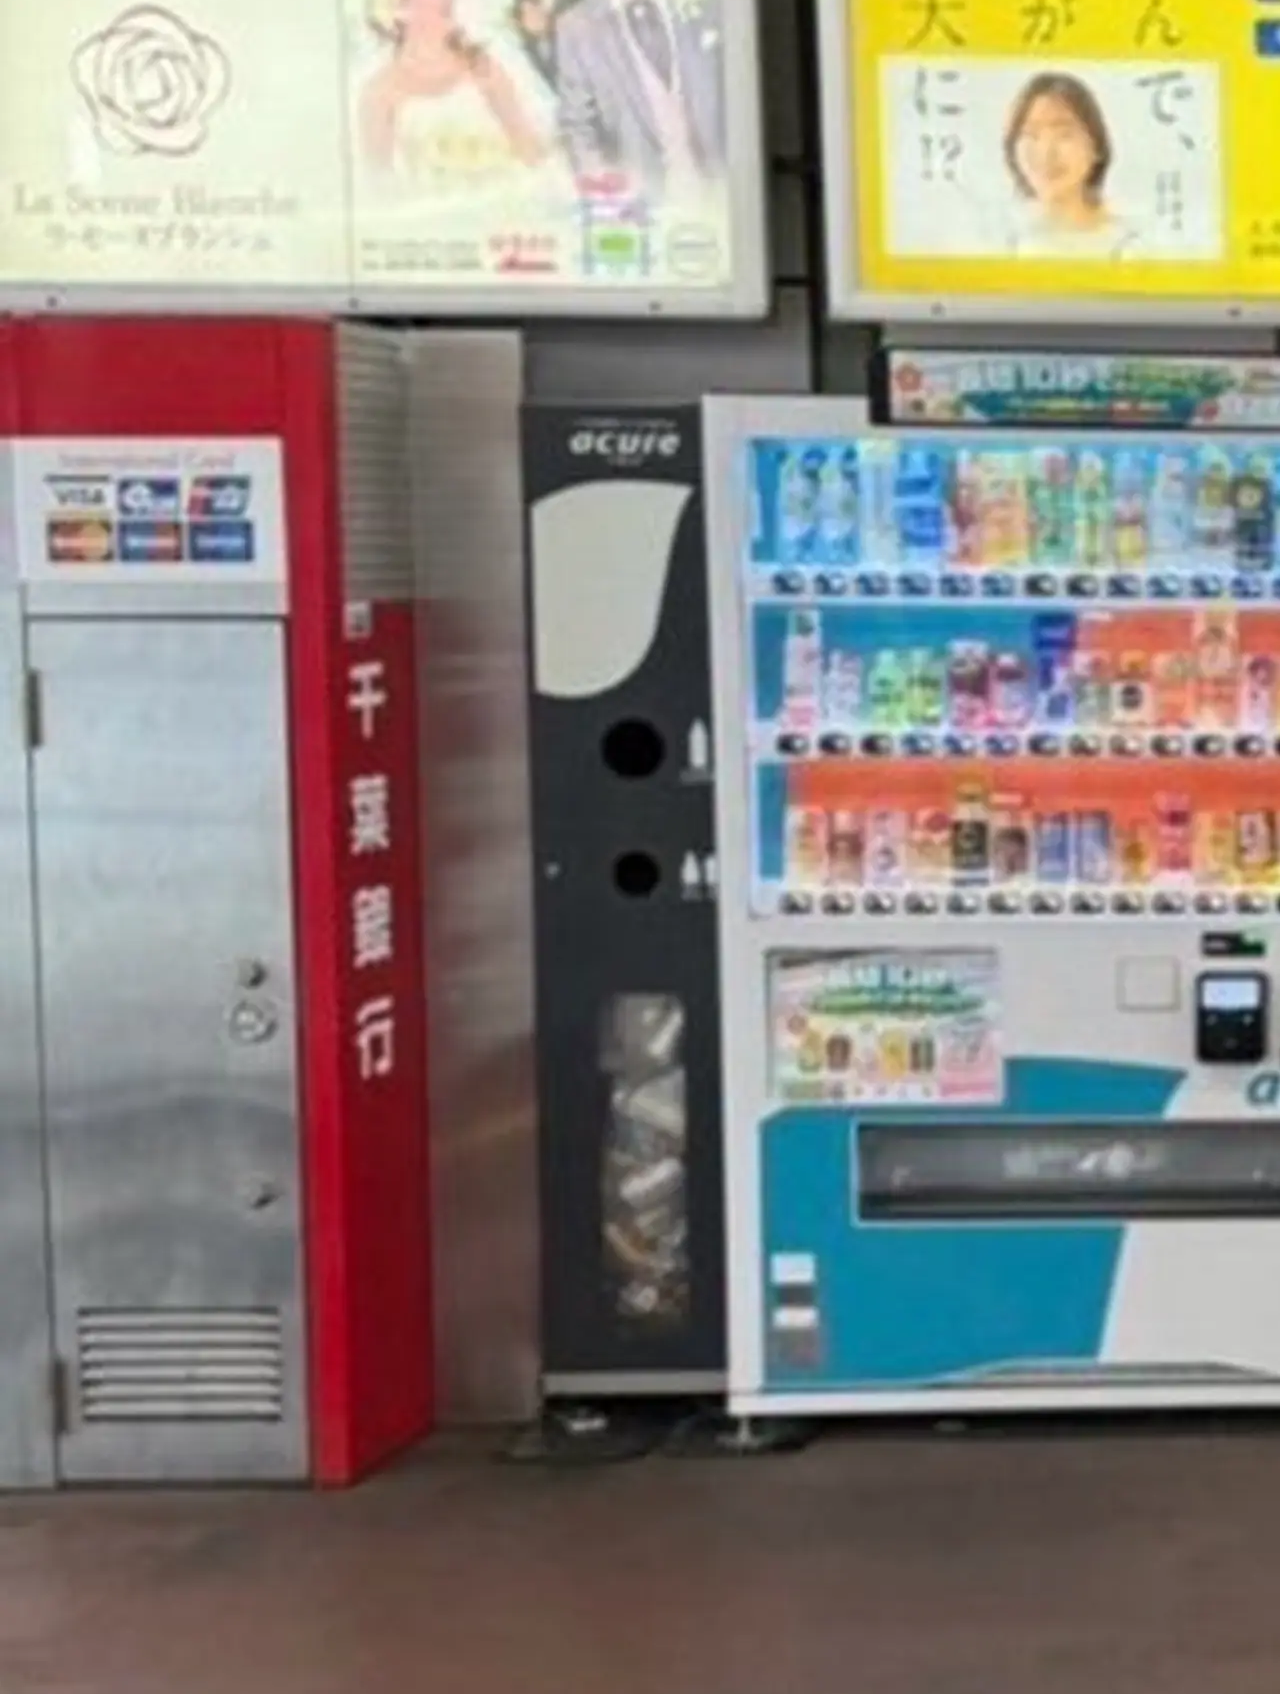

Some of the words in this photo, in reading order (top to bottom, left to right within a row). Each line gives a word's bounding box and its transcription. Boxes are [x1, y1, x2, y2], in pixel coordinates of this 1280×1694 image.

[568, 429, 681, 456] acure
[59, 453, 181, 469] International
[185, 453, 236, 469] Card
[57, 487, 106, 506] VISA
